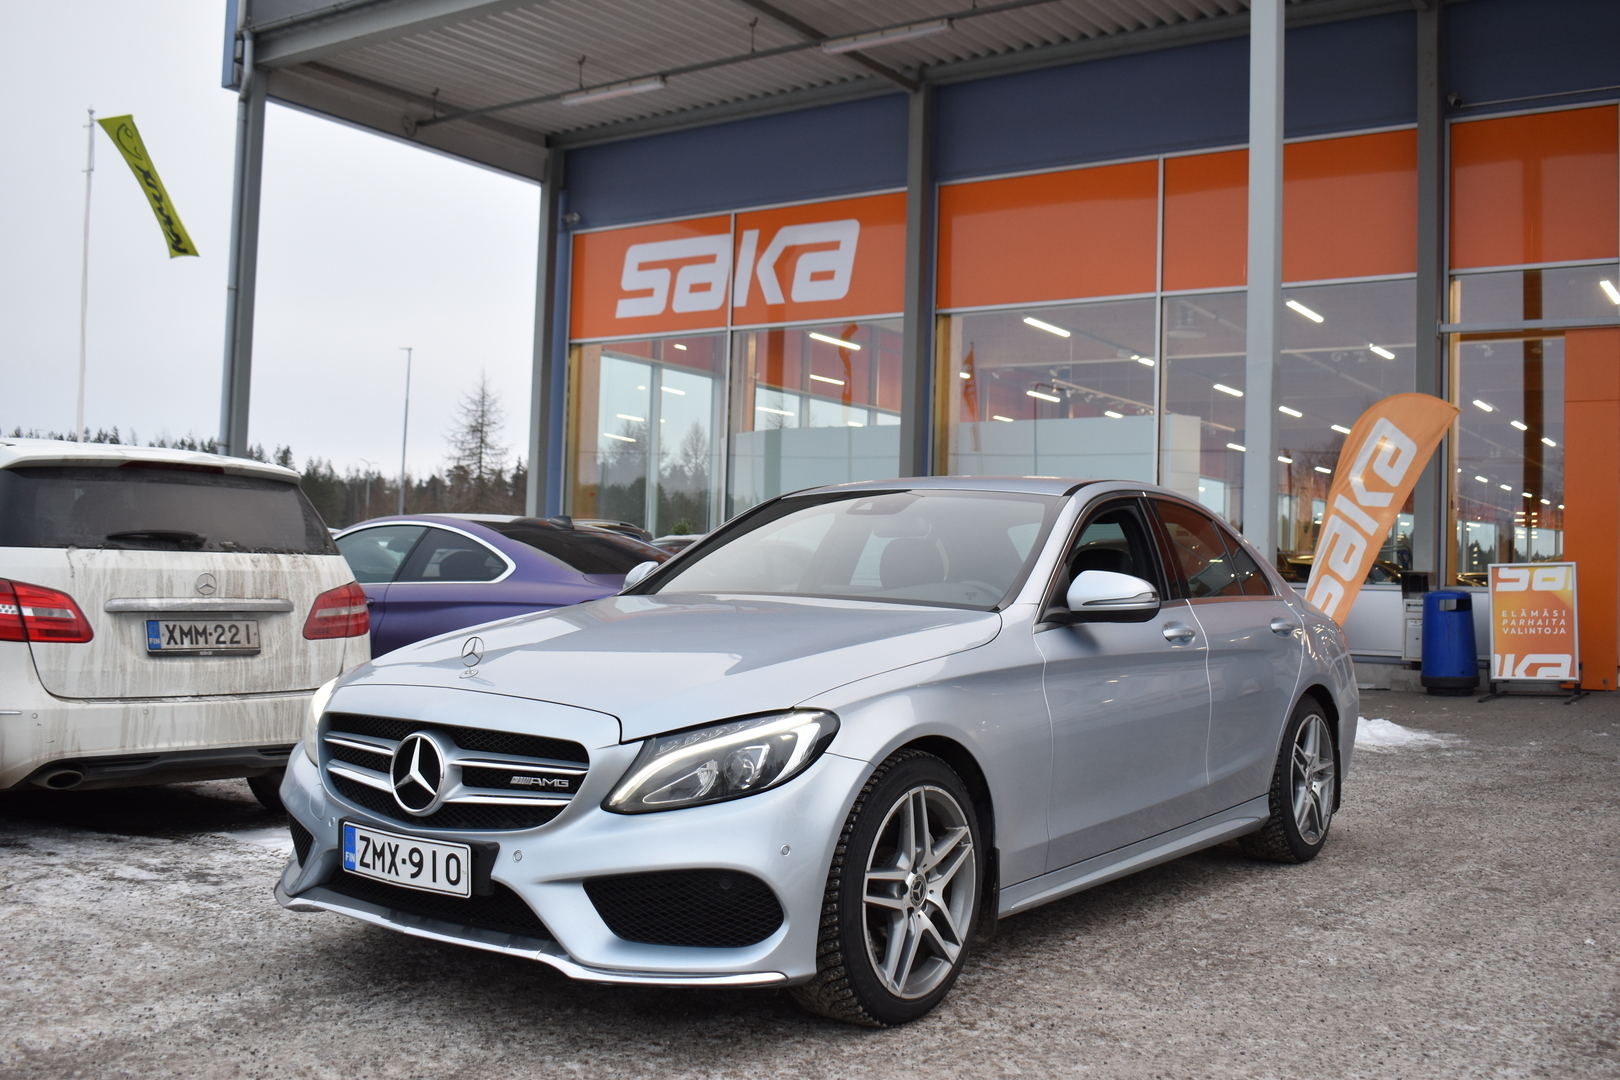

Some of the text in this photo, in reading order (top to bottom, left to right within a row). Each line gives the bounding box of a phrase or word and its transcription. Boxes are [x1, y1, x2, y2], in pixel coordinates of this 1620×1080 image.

[1502, 608, 1566, 618] ELÄMÄSI
[1502, 618, 1566, 626] PARHAITA
[165, 624, 251, 645] XMM-221
[1502, 627, 1566, 635] VALINTOJA
[530, 777, 569, 788] AMG
[345, 834, 461, 886] FIN ZMX-910
